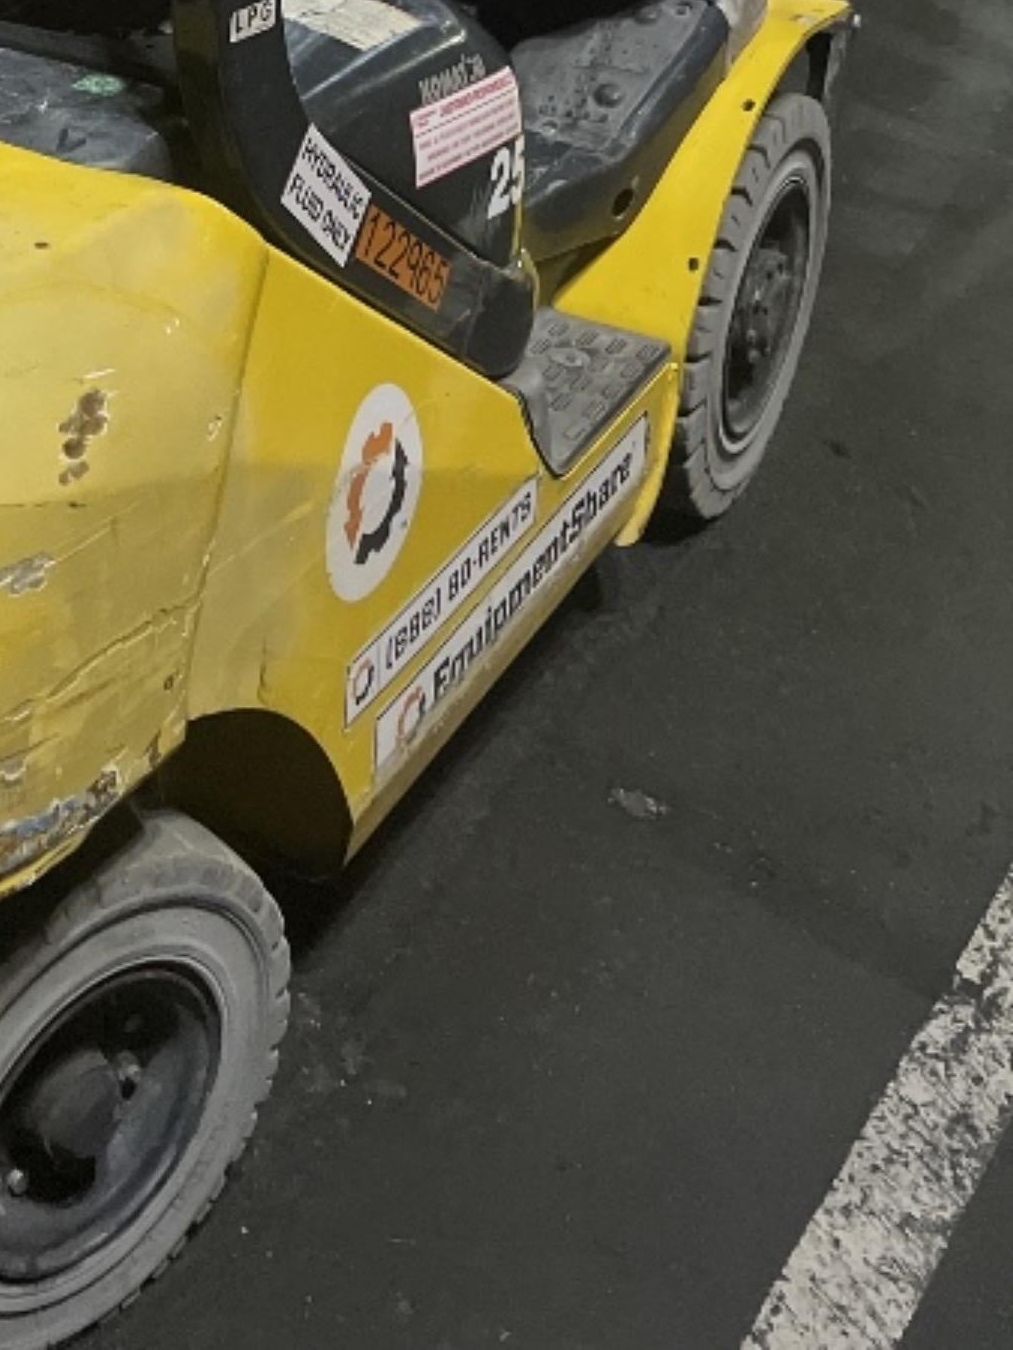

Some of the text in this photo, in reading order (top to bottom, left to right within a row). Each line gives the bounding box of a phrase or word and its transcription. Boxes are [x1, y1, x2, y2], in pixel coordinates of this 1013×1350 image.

[234, 0, 274, 33] LPG
[287, 172, 352, 251] FLUID ONLY
[301, 137, 364, 220] HYDRAULIC
[364, 210, 450, 306] 122965
[385, 491, 533, 670] (888) 80-RENTS
